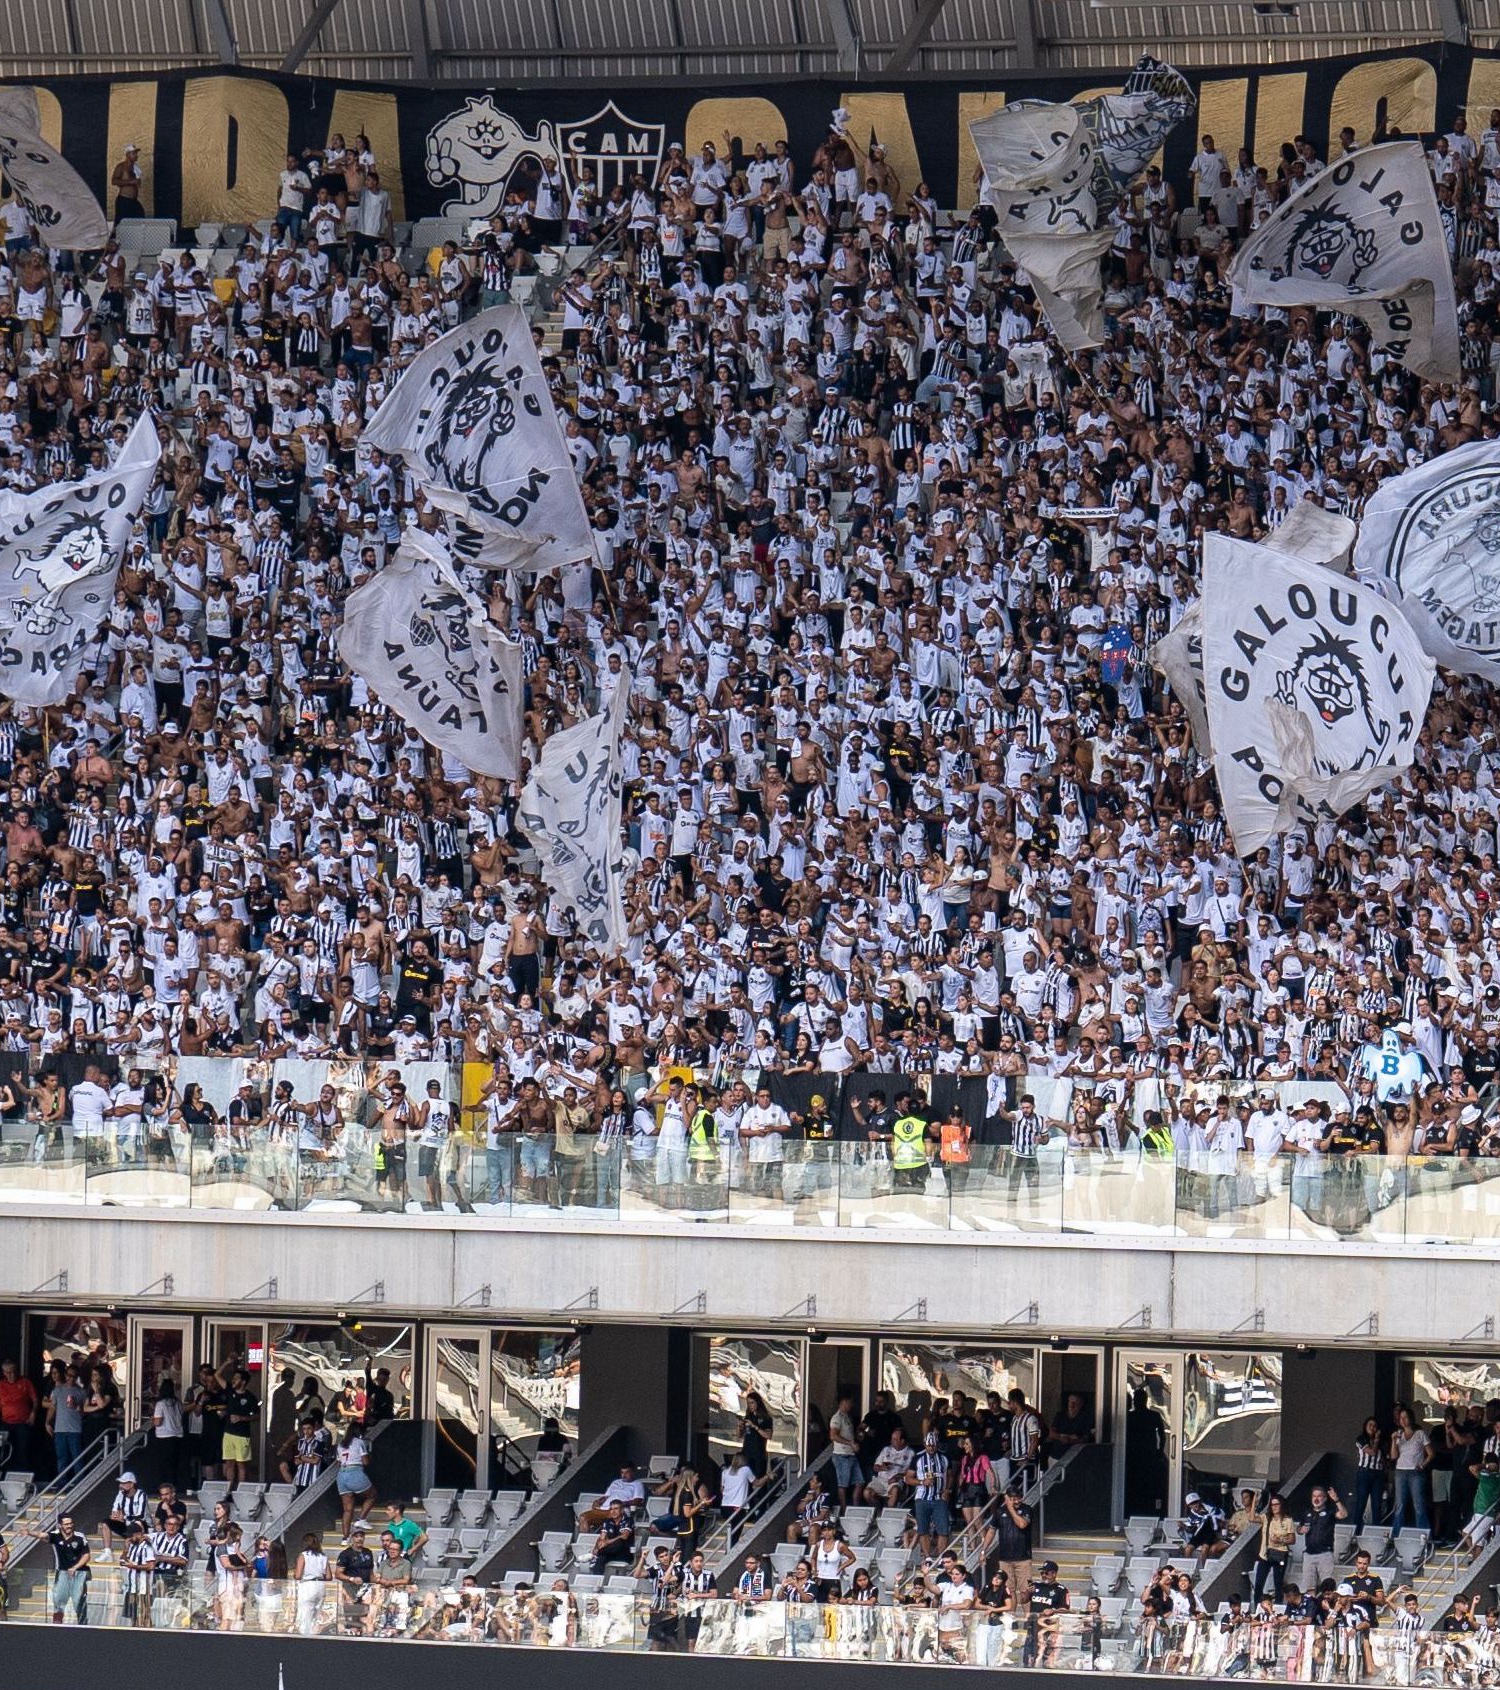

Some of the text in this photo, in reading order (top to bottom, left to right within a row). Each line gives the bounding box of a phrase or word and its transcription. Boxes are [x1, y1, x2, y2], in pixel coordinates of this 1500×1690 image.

[568, 130, 649, 155] CAM
[1220, 583, 1415, 766] GALOUCUR
[1380, 1055, 1399, 1076] B
